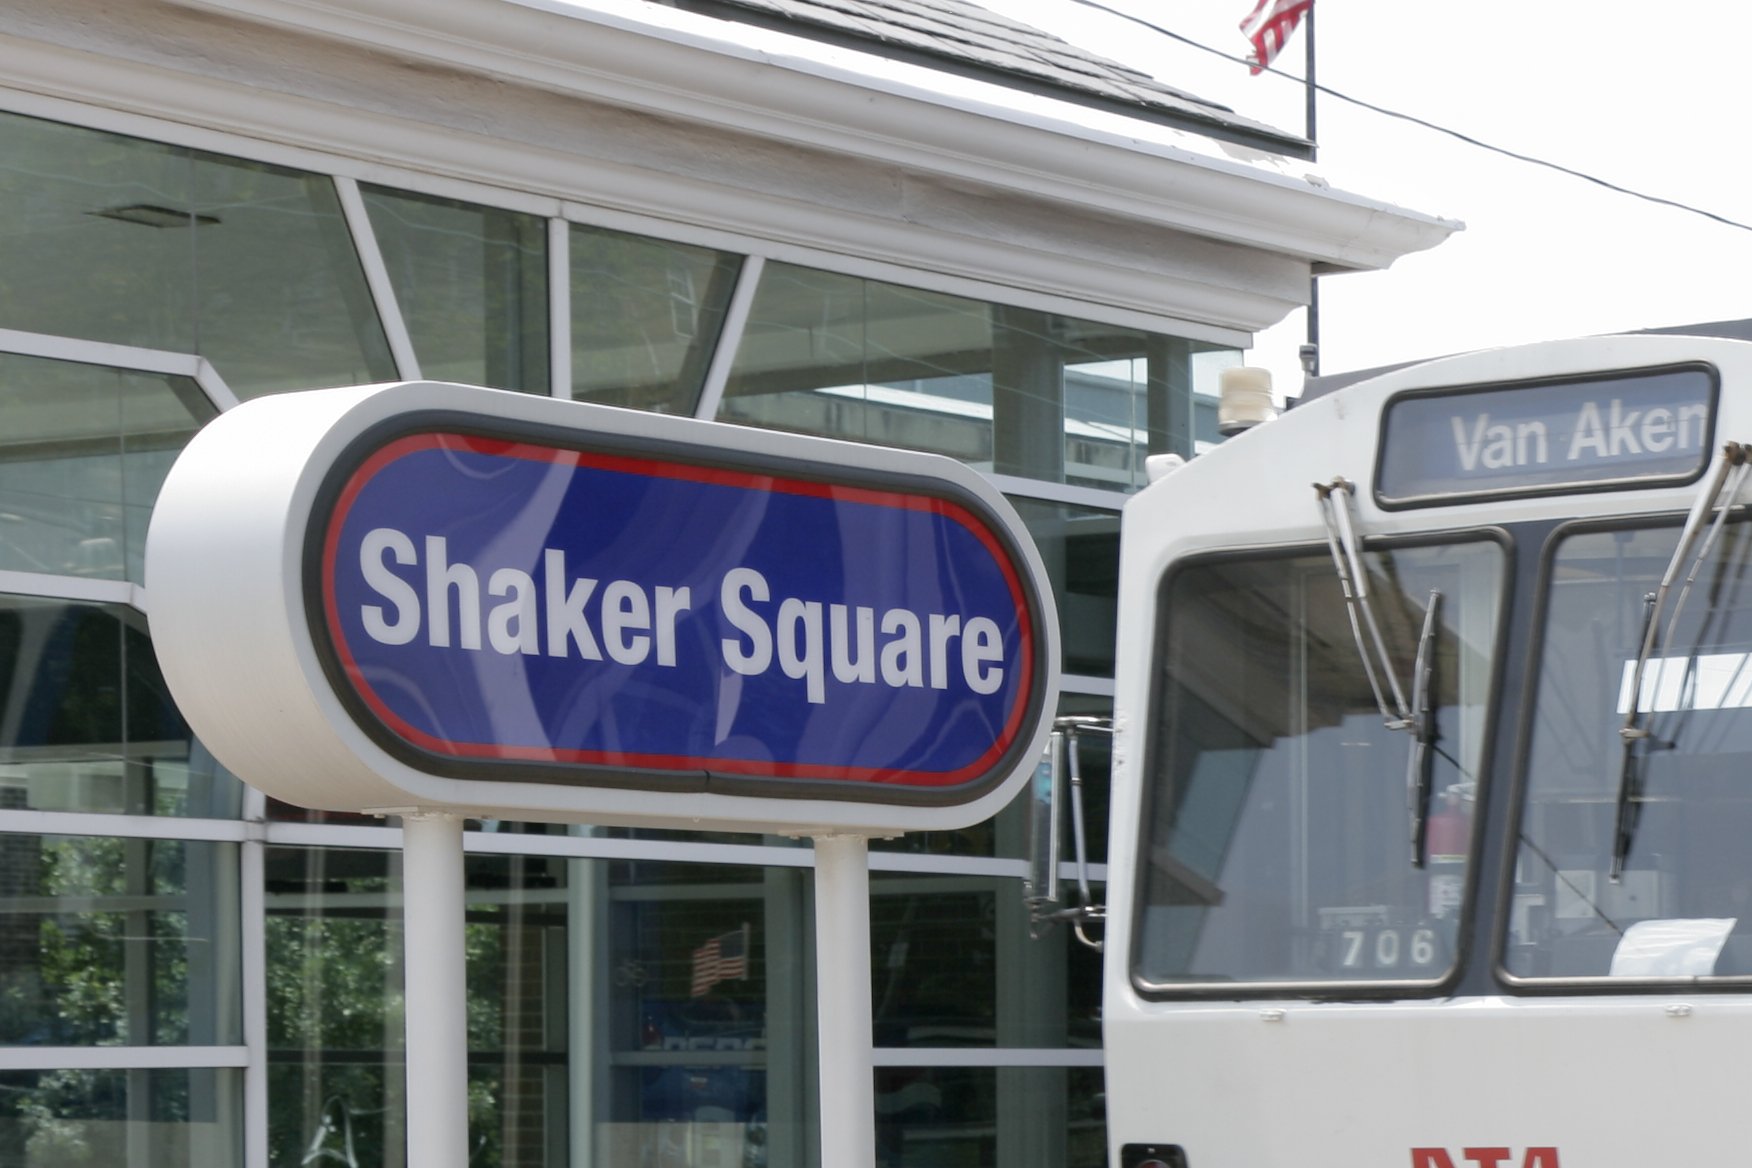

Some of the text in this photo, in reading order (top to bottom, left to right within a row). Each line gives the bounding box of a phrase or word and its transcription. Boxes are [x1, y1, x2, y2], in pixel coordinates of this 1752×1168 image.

[1451, 398, 1709, 471] Van Aken
[359, 527, 1005, 704] Shaker Square
[1341, 928, 1434, 966] 706
